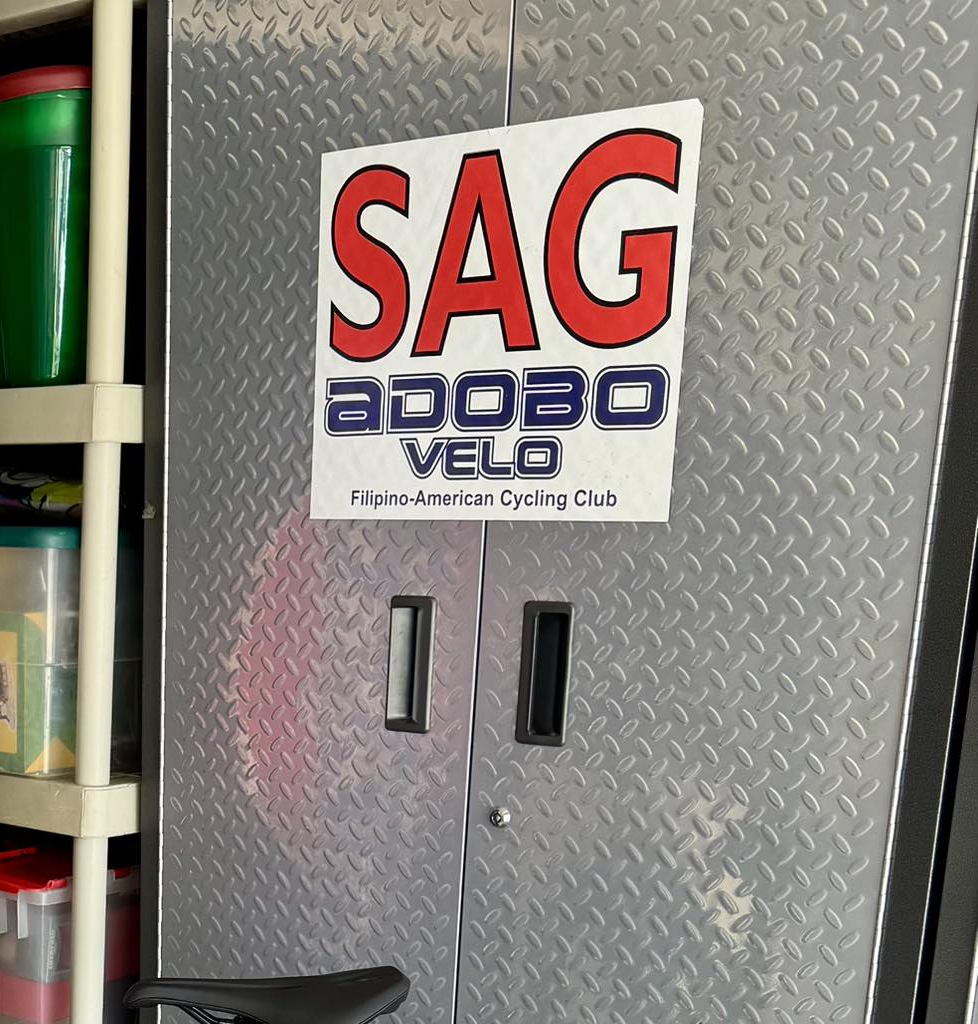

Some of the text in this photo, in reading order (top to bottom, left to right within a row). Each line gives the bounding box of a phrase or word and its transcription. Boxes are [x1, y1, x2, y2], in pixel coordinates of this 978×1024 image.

[329, 127, 682, 362] SAG
[399, 435, 563, 480] VELO
[351, 489, 617, 511] Filipino-American Cycling Club
